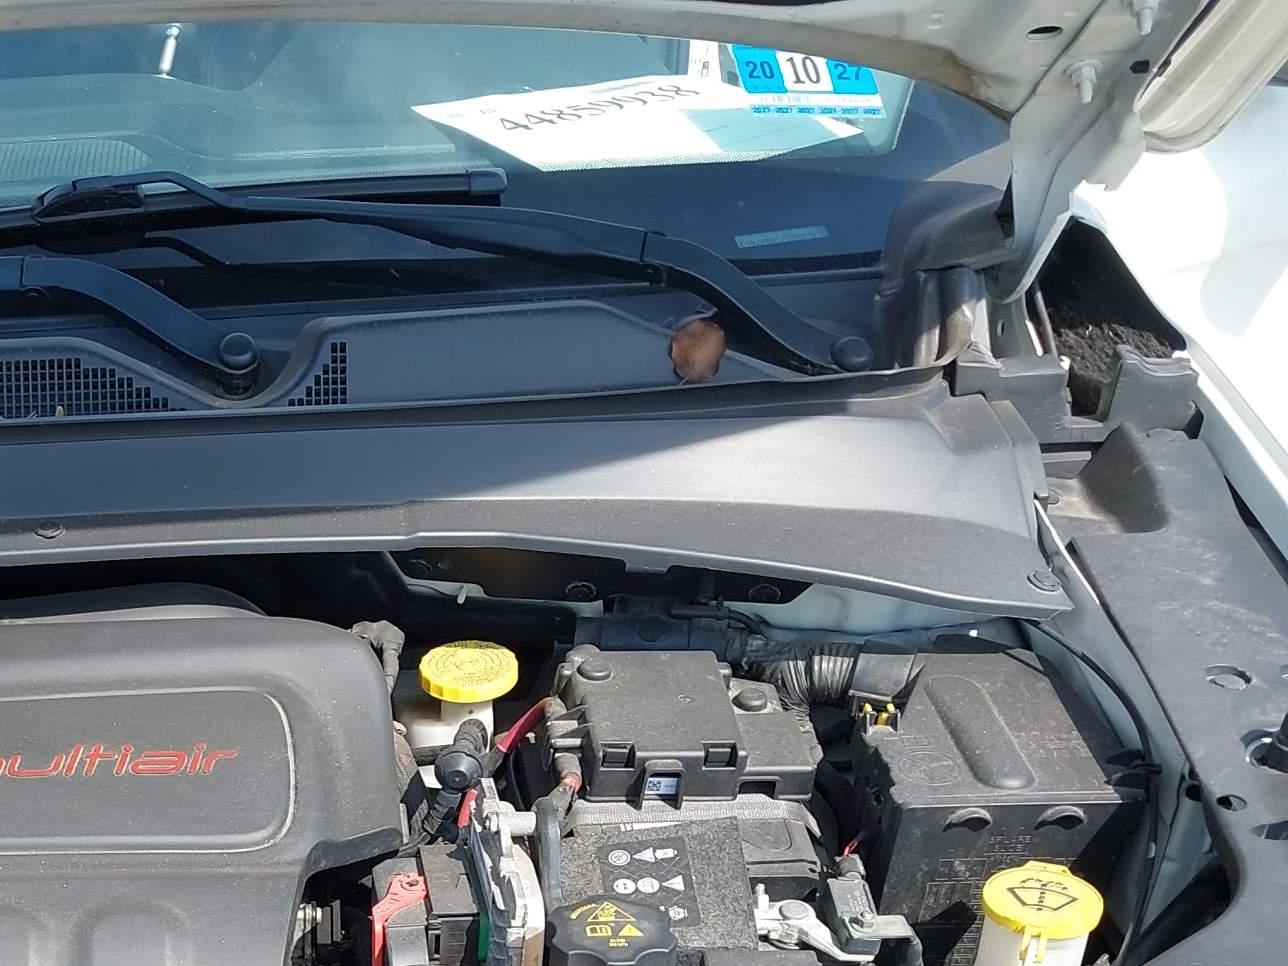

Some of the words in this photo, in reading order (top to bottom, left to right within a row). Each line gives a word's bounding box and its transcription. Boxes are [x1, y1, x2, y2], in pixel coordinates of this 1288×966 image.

[745, 60, 775, 80] 20
[785, 56, 821, 85] 10
[833, 63, 862, 81] 27
[500, 84, 700, 131] 44859938
